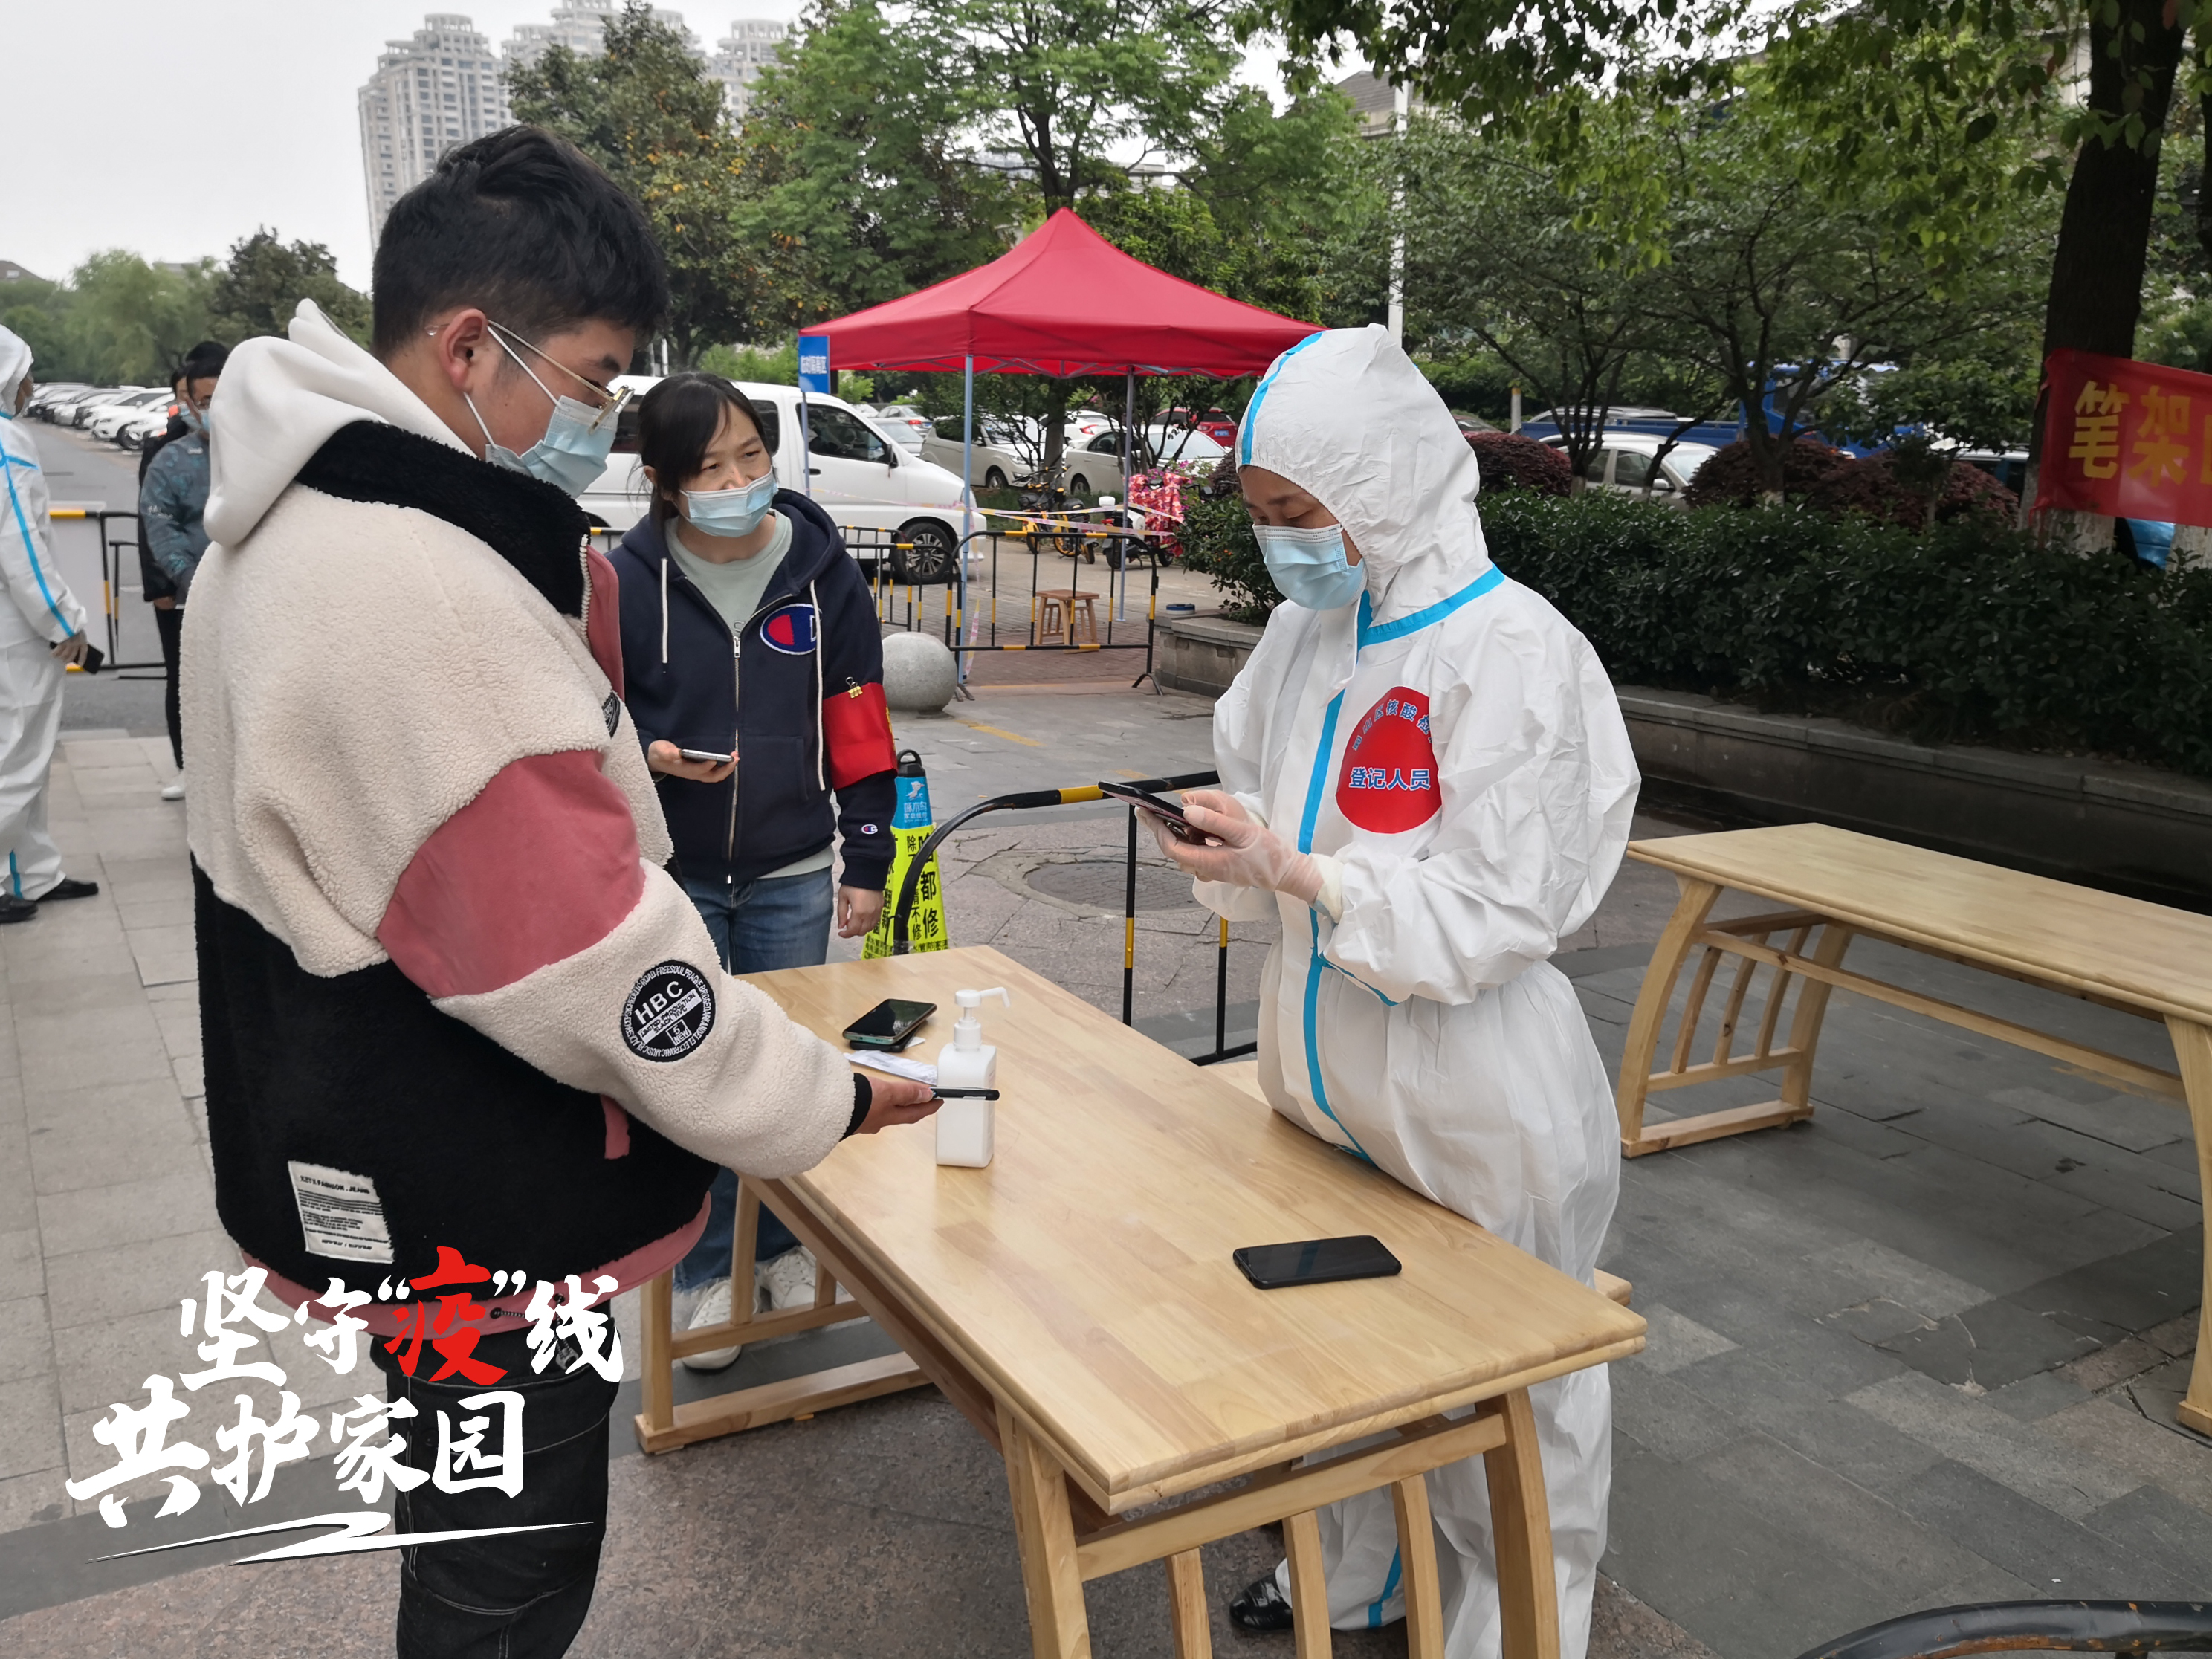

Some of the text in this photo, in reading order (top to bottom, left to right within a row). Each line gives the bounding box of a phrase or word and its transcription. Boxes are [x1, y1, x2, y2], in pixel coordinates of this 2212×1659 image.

[2069, 380, 2212, 488] 笔架
[1349, 766, 1432, 791] 登记人员
[634, 980, 683, 1025] HBC
